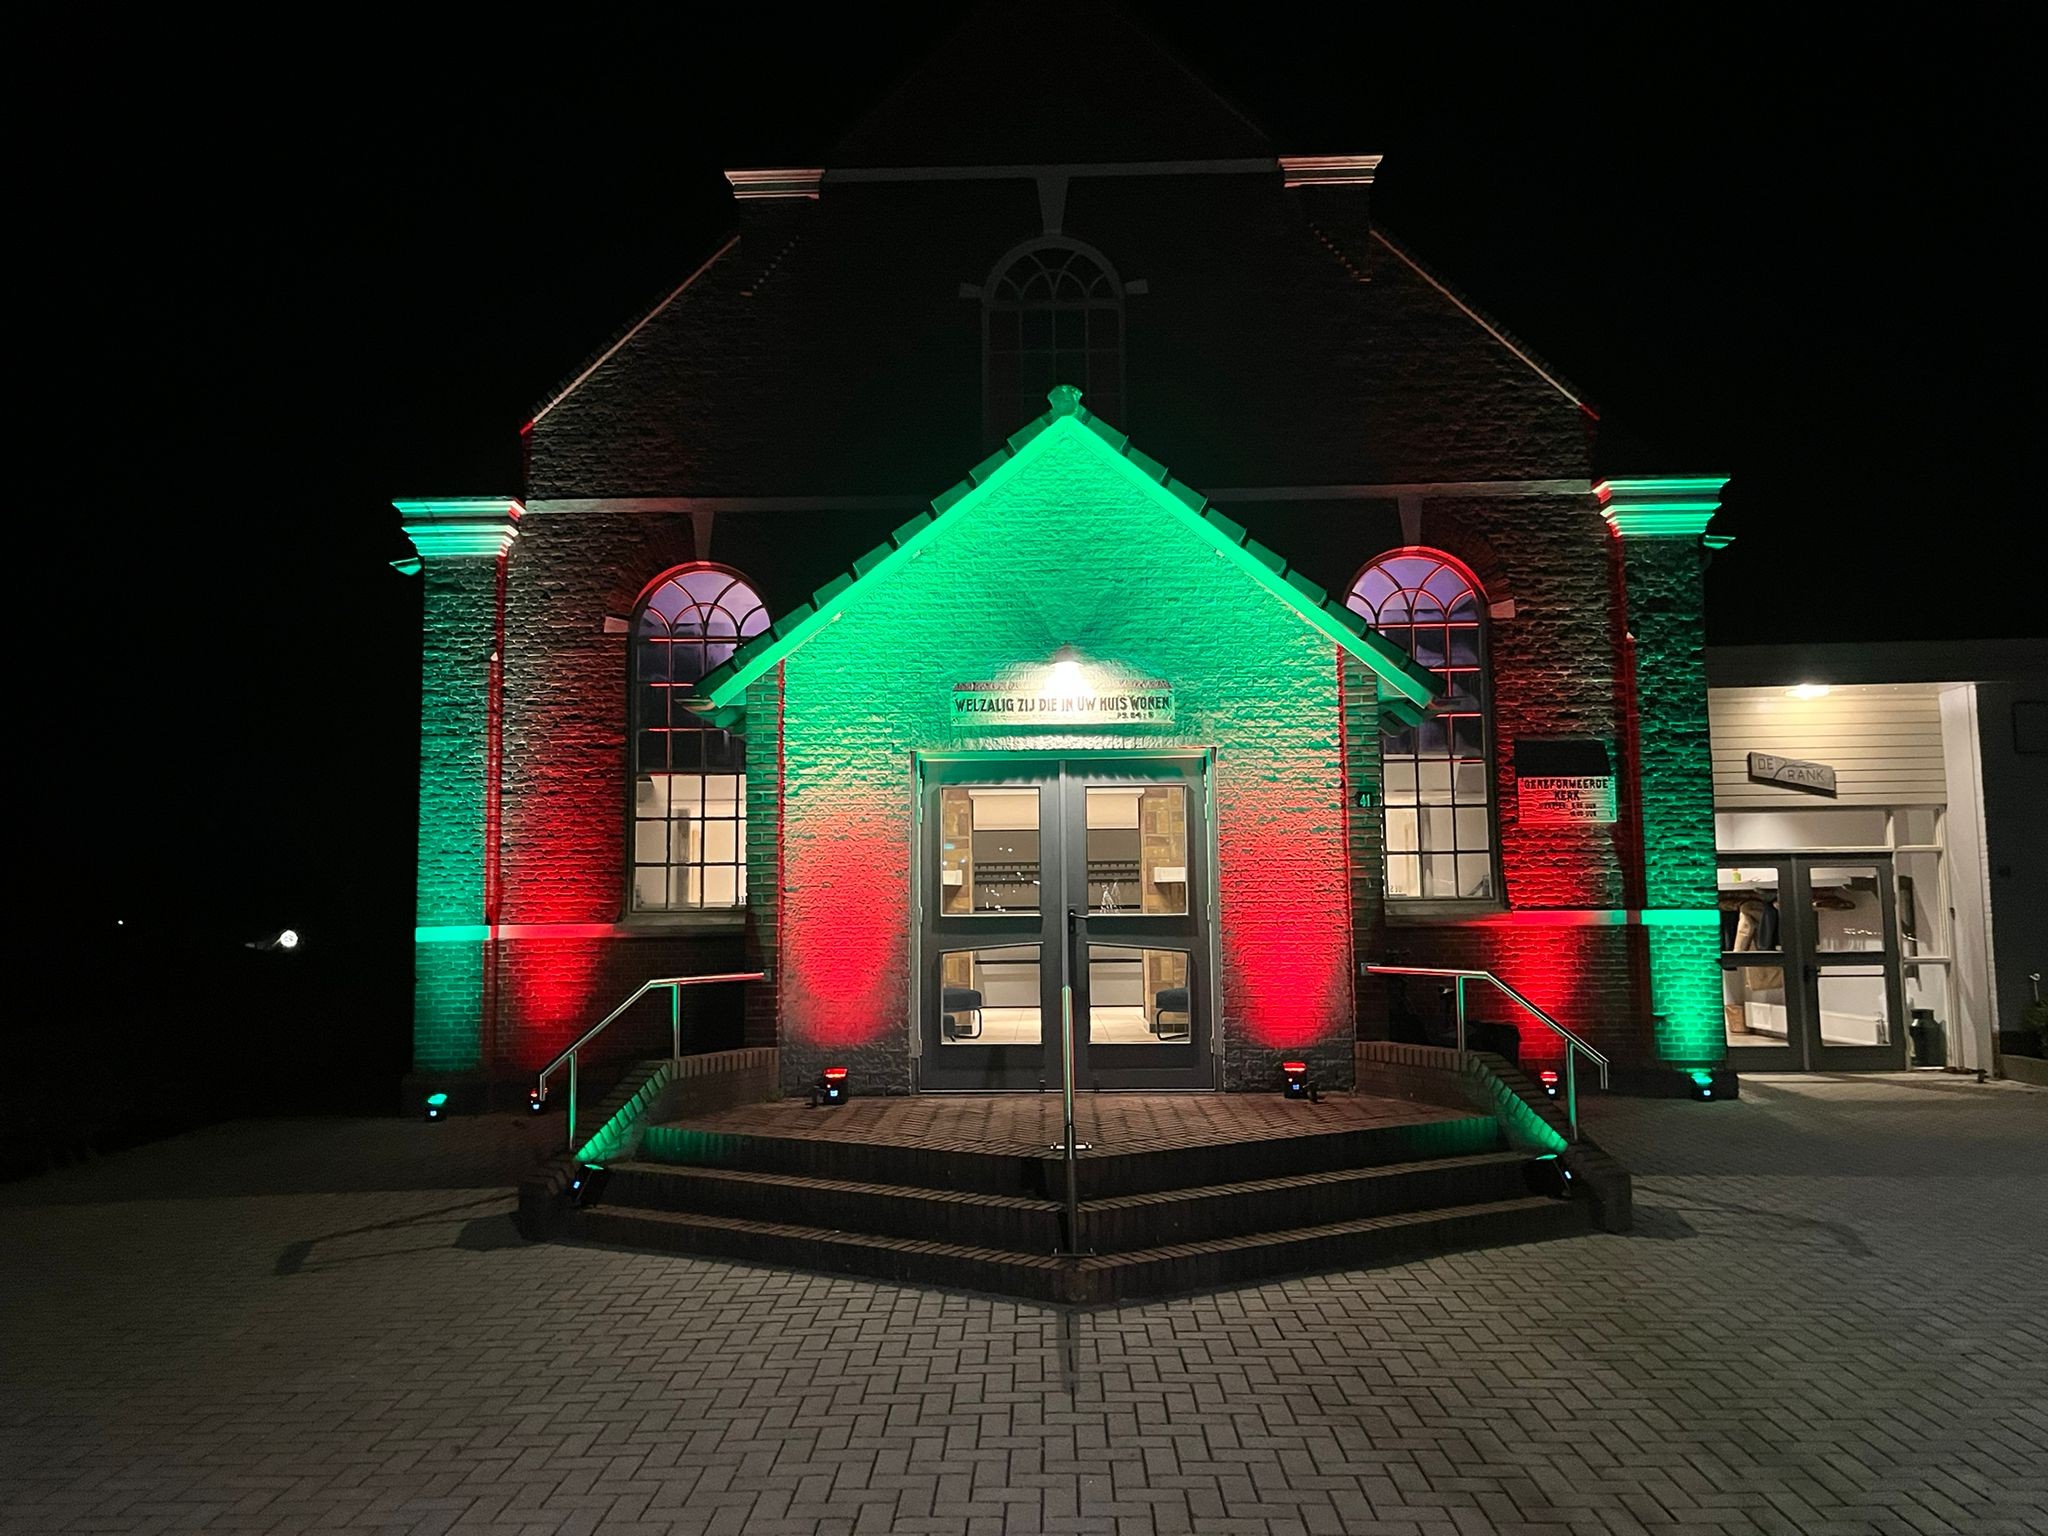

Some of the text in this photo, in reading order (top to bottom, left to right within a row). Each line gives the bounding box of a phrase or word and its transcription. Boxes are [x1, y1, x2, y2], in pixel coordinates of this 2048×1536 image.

[955, 696, 1169, 712] WELZALIG ZIJ DIE IN UW HUIS WONEN
[1757, 758, 1825, 781] DE RANK
[1360, 793, 1371, 807] 41
[1554, 790, 1581, 801] KERK
